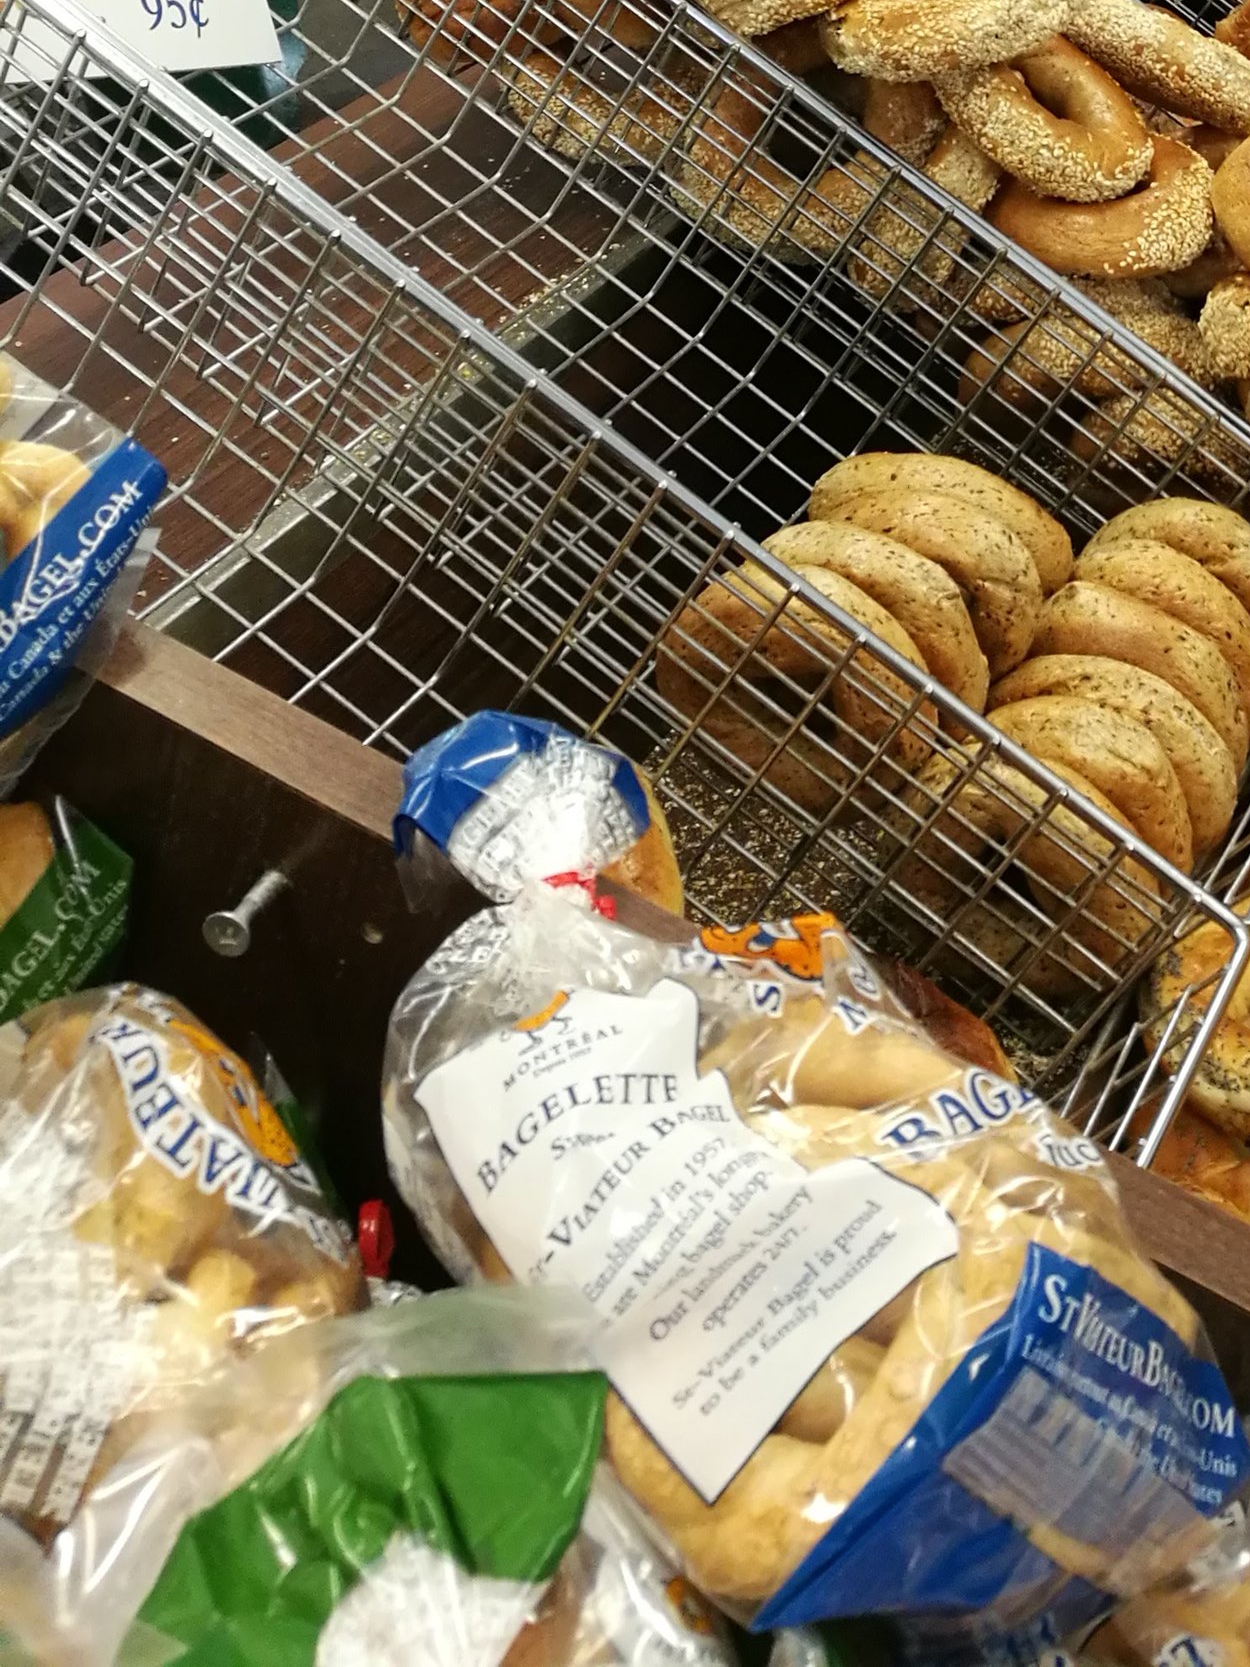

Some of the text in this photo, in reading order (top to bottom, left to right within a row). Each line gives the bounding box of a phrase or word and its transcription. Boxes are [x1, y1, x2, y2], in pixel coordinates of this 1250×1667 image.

[8, 620, 60, 681] Canada
[57, 603, 75, 625] et
[71, 576, 99, 609] aux
[475, 1072, 680, 1197] BAGELETTE
[648, 1104, 732, 1140] BAGEL
[660, 1180, 687, 1202] in
[684, 1137, 726, 1177] 1957
[680, 1210, 732, 1262] bagel
[766, 1260, 820, 1316] Bagel
[814, 1248, 836, 1267] is
[834, 1198, 884, 1255] proud
[650, 1300, 690, 1341] Our
[702, 1261, 769, 1331] operates
[718, 1367, 745, 1391] be
[748, 1353, 761, 1367] a
